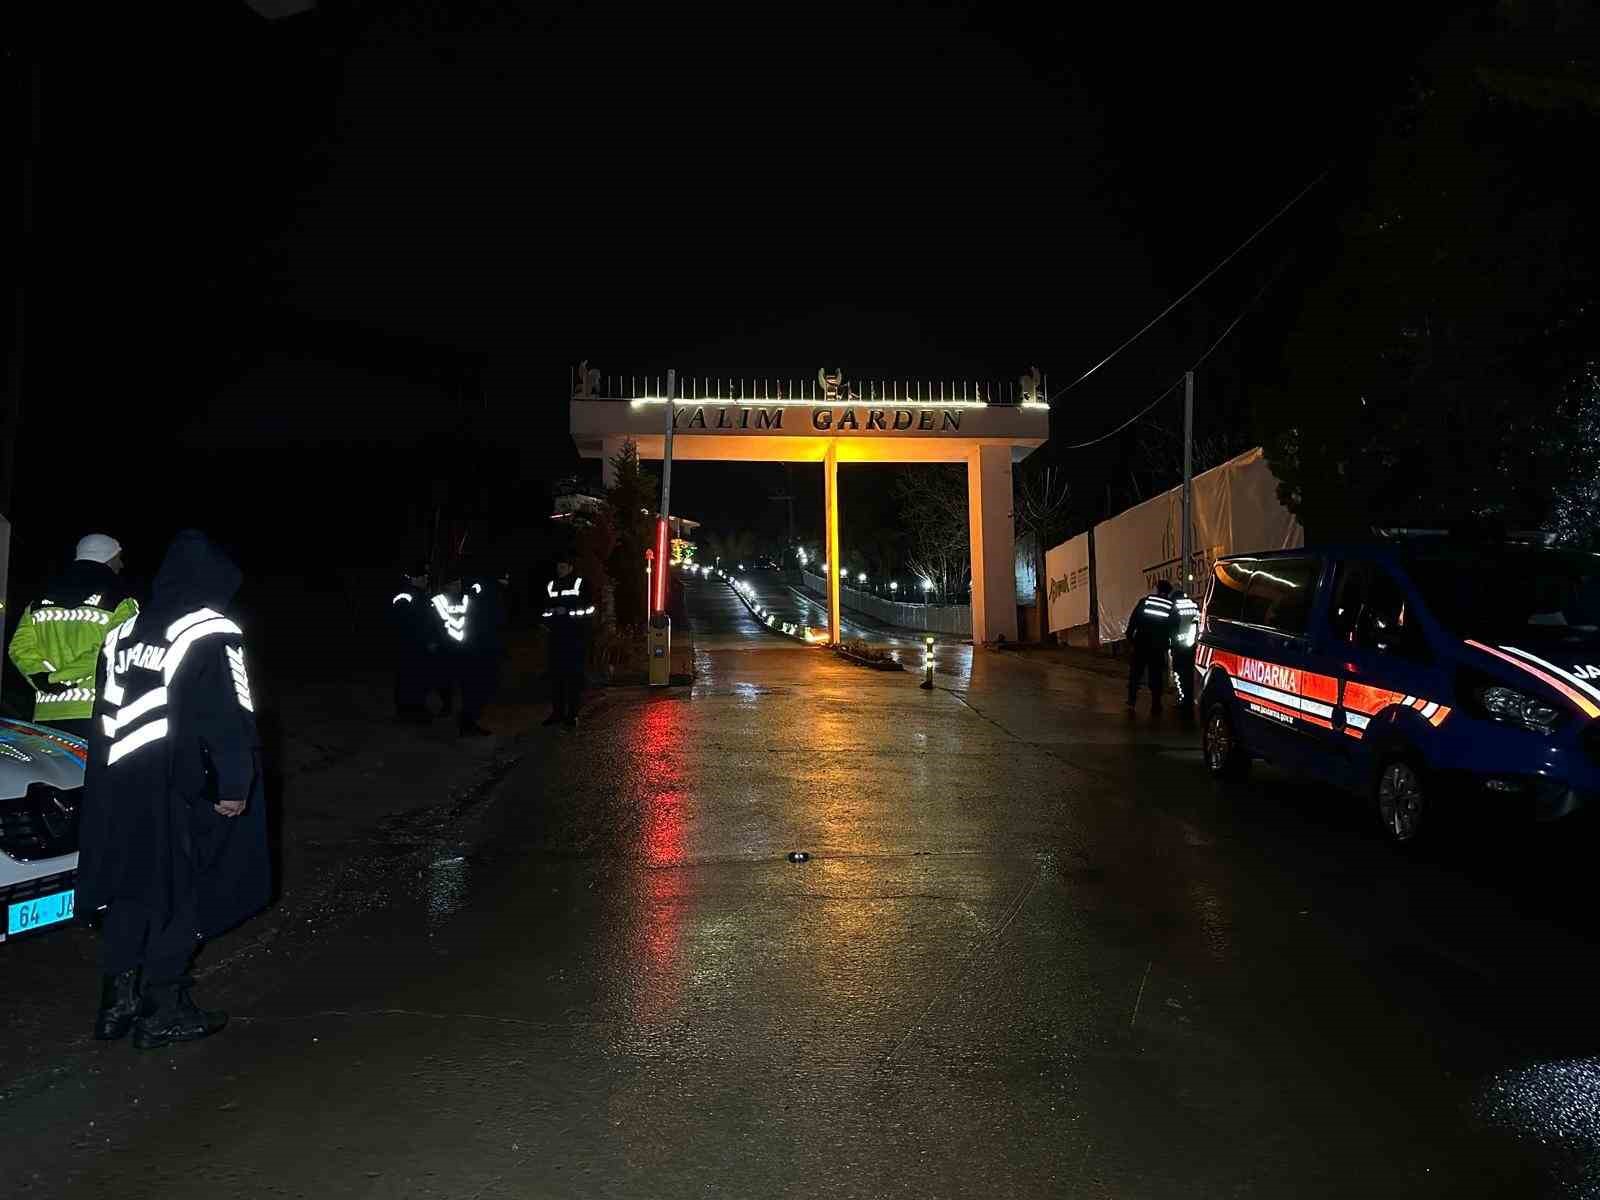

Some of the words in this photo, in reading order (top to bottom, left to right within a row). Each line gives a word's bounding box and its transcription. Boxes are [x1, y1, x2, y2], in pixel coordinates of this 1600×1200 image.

[671, 407, 784, 429] YALIM
[813, 409, 963, 431] GARDEN
[1239, 657, 1297, 693] JANDARMA
[19, 902, 40, 928] 64
